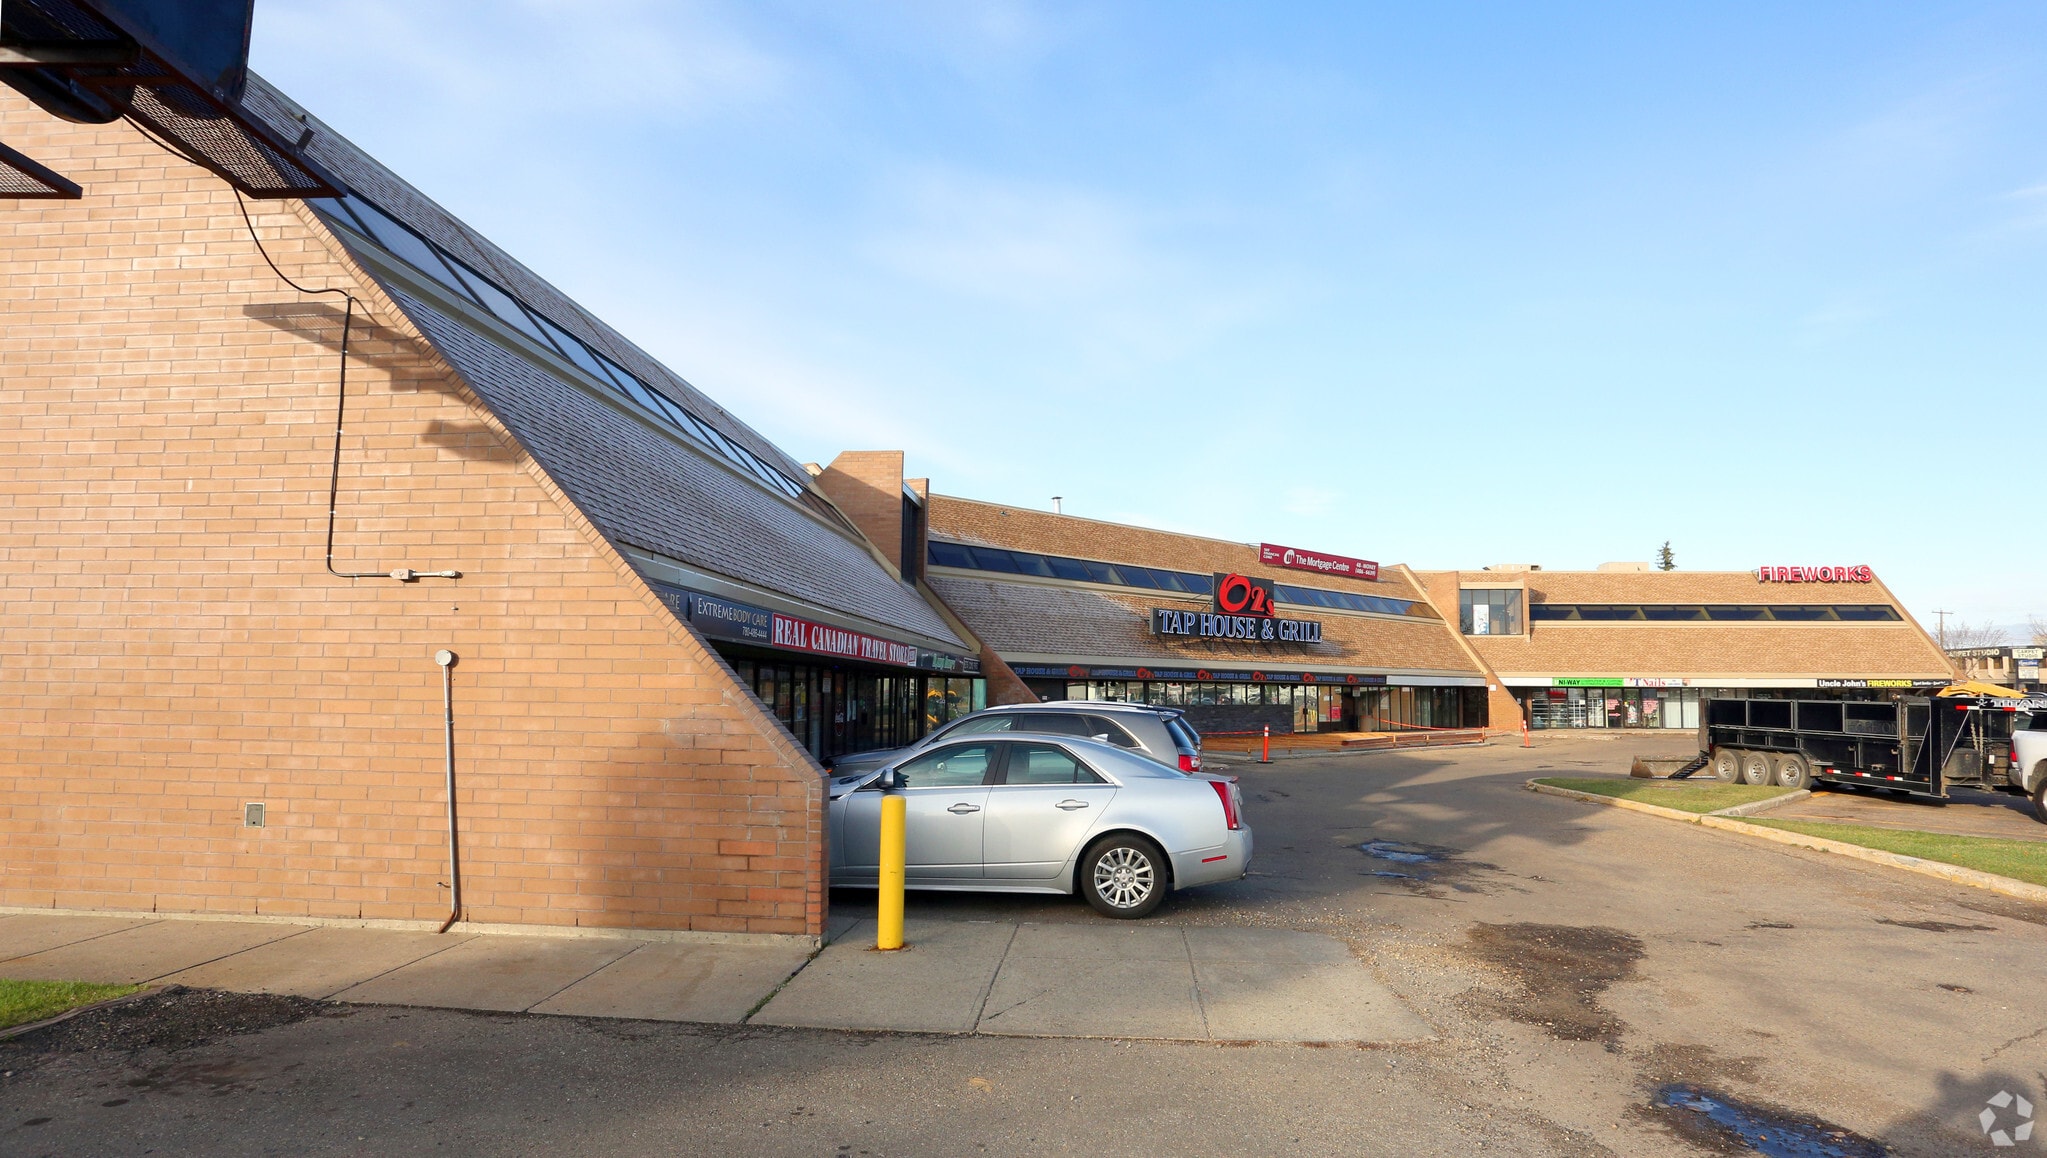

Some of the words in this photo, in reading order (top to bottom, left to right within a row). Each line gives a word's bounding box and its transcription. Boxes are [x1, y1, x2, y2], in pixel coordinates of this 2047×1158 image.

[1296, 554, 1306, 564] The
[1307, 557, 1333, 571] Mortgage
[1333, 561, 1350, 572] Centre
[1758, 565, 1872, 582] FIREWORKS
[664, 592, 680, 609] RE
[752, 613, 767, 628] CARE
[1158, 610, 1196, 635] TAP
[1199, 613, 1256, 639] HOUSE
[1261, 618, 1275, 640] &
[1278, 620, 1322, 643] GRILL
[774, 617, 807, 648] REAL
[811, 626, 859, 656] CANADIAN
[861, 637, 888, 661] TRAVEL
[889, 643, 909, 663] STORE
[1972, 648, 2000, 657] STUDIO
[1643, 677, 1666, 687] Nails
[1990, 699, 2047, 708] TITAN
